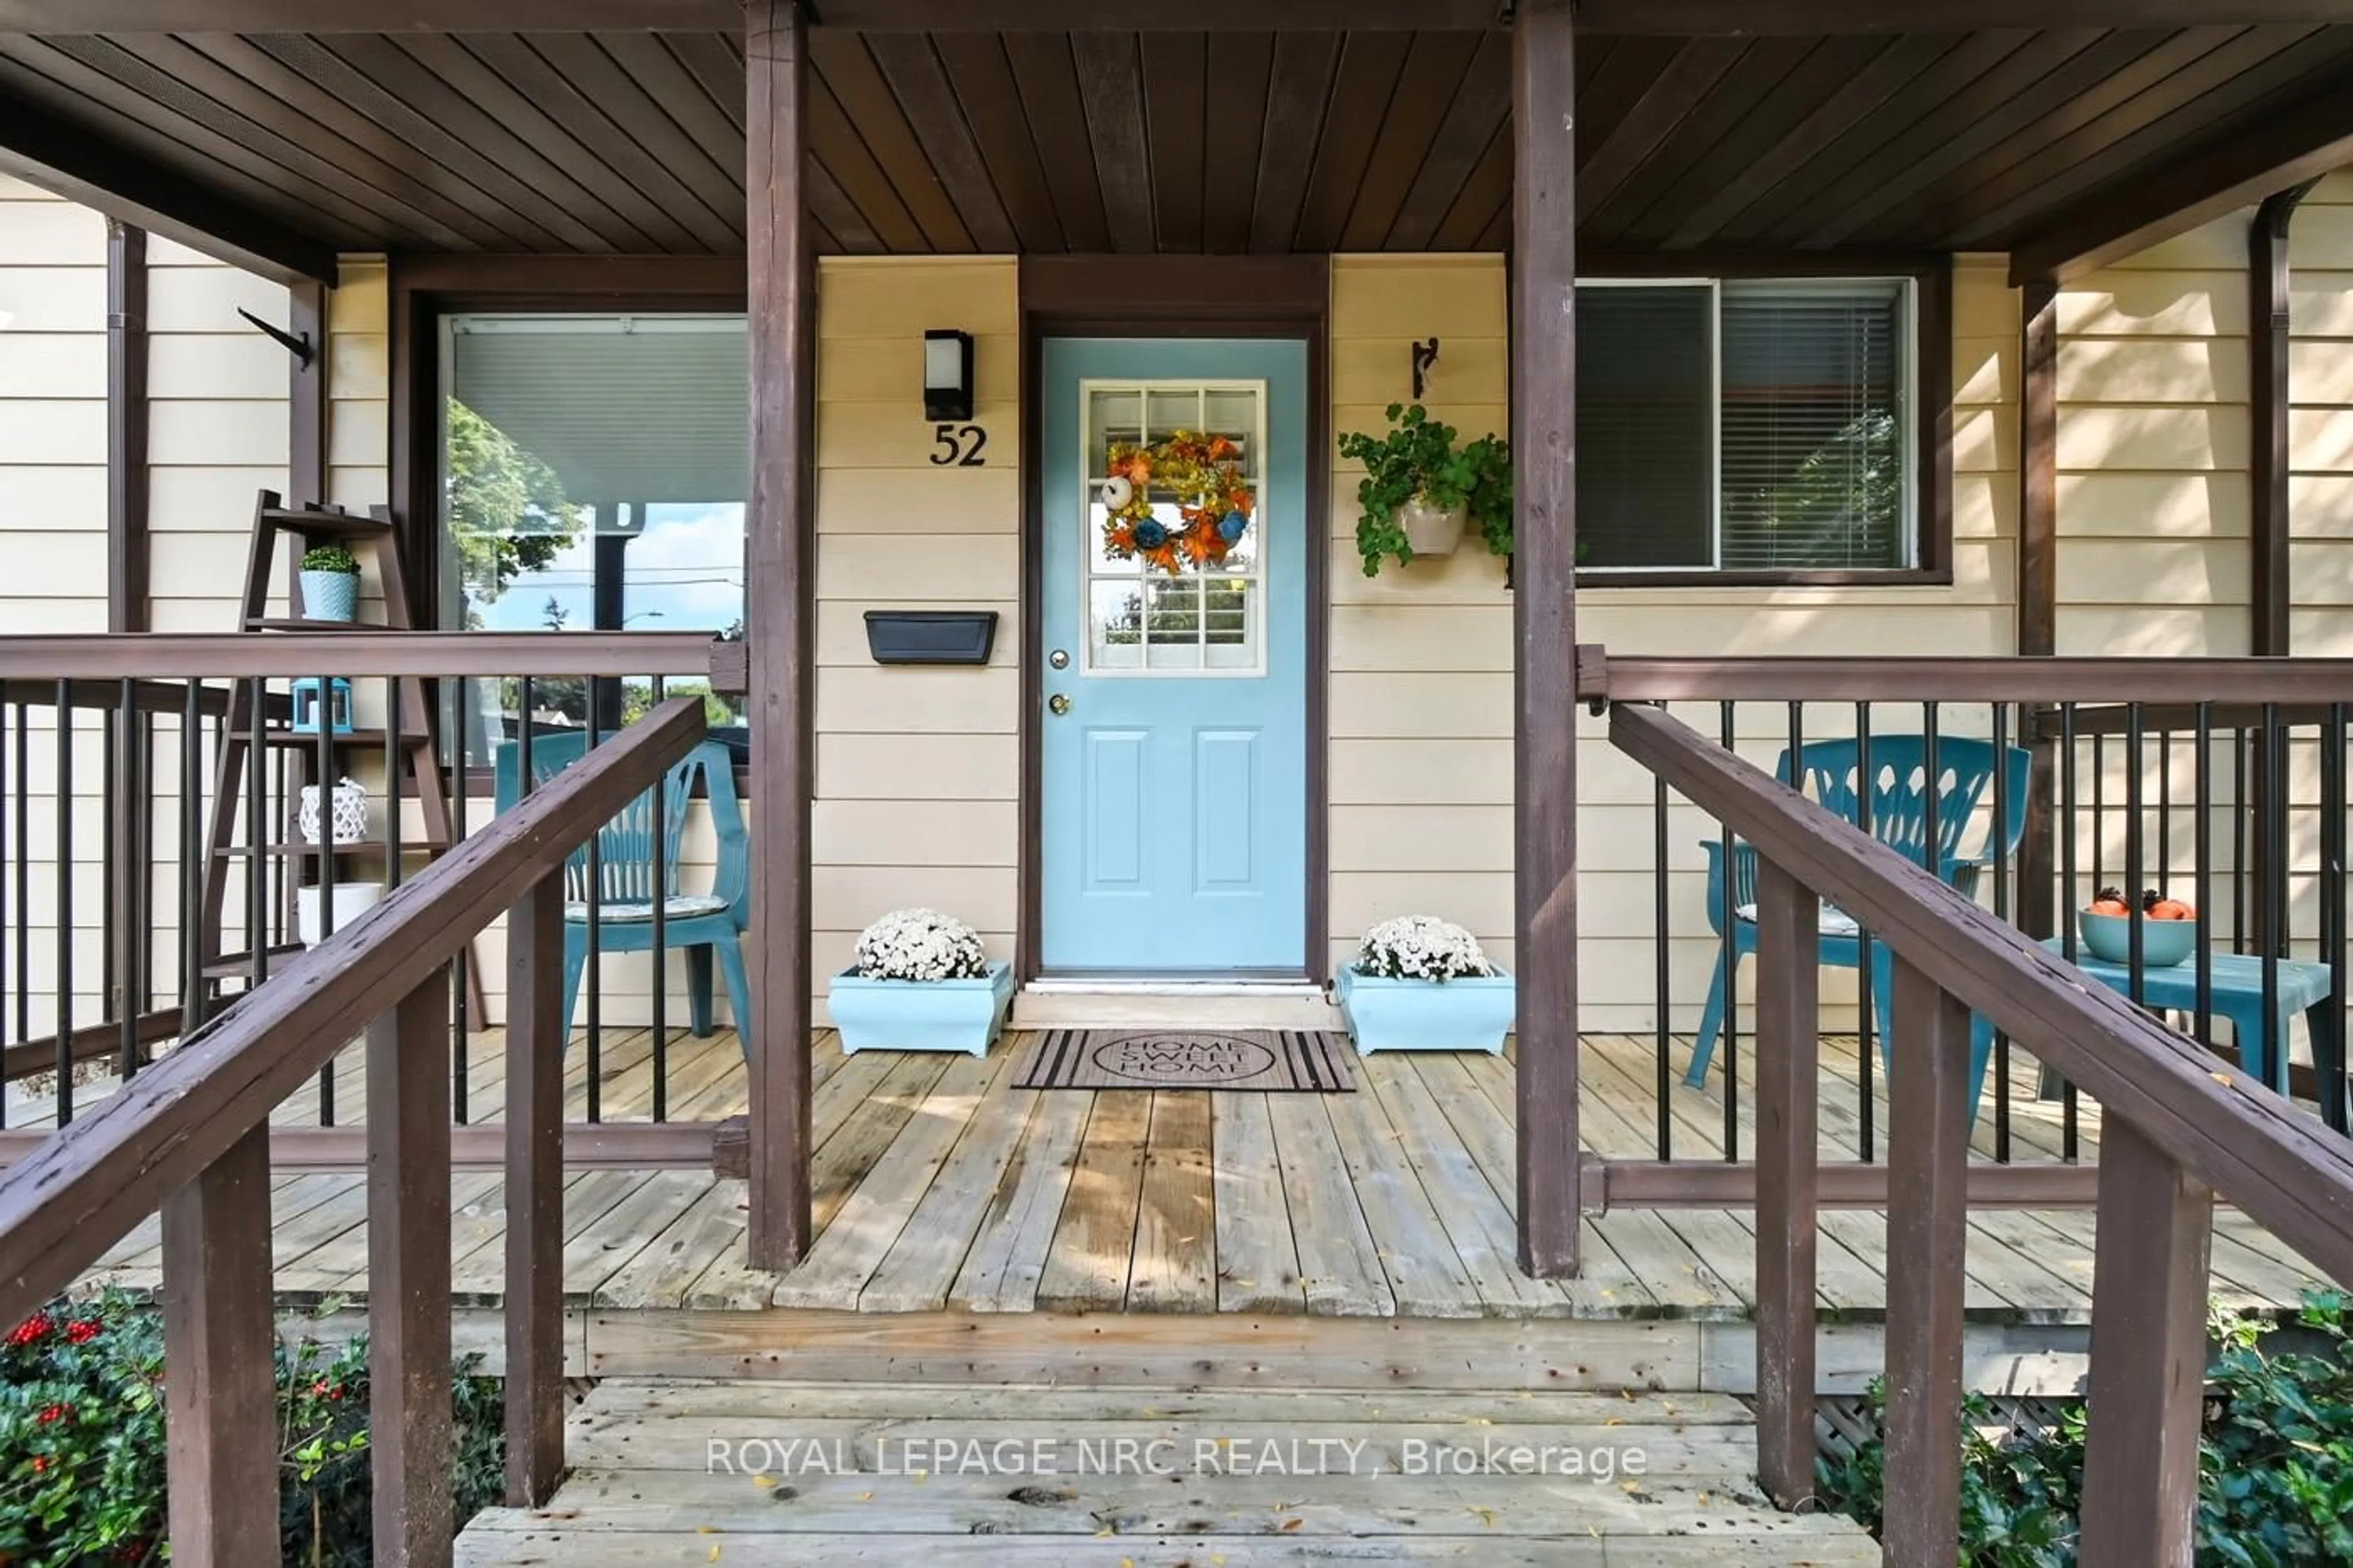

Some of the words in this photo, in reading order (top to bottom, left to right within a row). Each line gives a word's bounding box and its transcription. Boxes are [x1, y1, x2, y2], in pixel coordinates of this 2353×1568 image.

[930, 424, 987, 466] 52
[1124, 1041, 1247, 1051] HOME
[1121, 1052, 1250, 1062] SWEET
[1120, 1062, 1252, 1073] HOME
